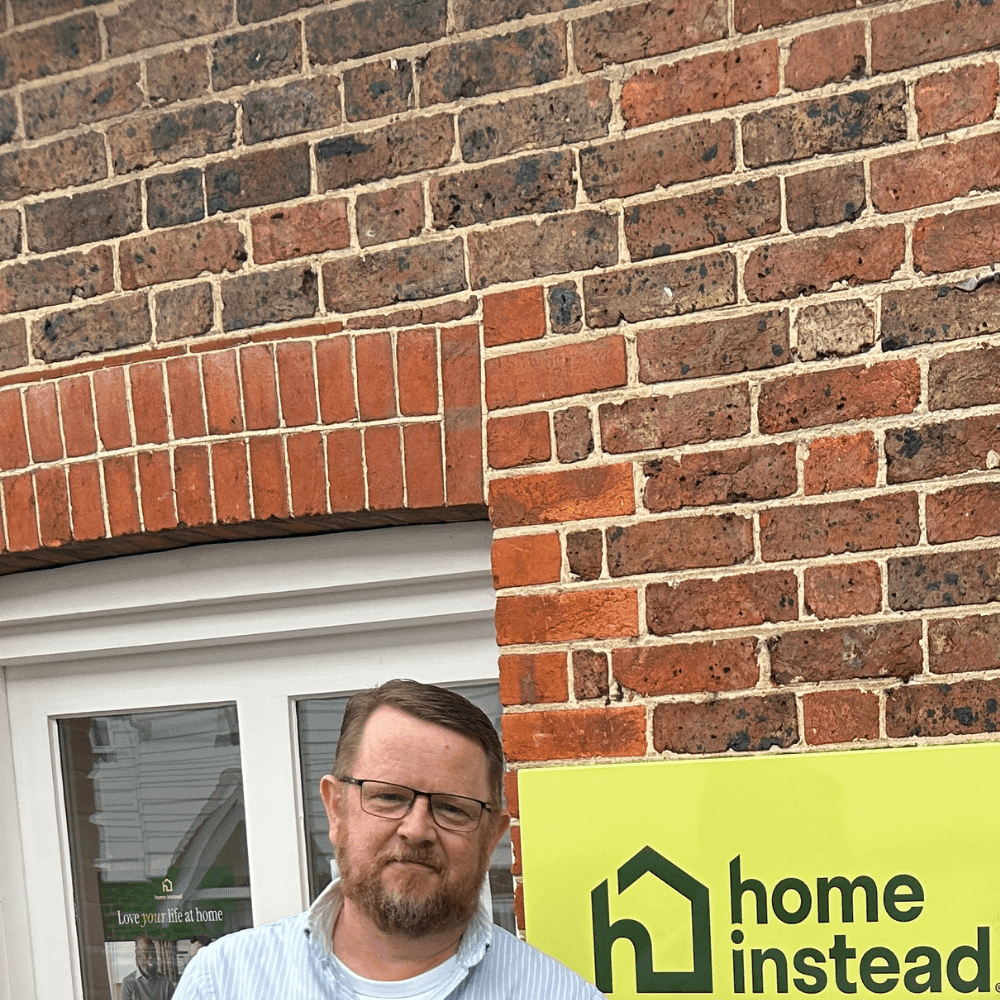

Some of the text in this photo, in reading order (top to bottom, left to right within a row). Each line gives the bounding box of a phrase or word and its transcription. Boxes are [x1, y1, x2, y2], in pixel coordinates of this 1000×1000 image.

[729, 854, 924, 925] home
[117, 906, 224, 928] Love your life at home
